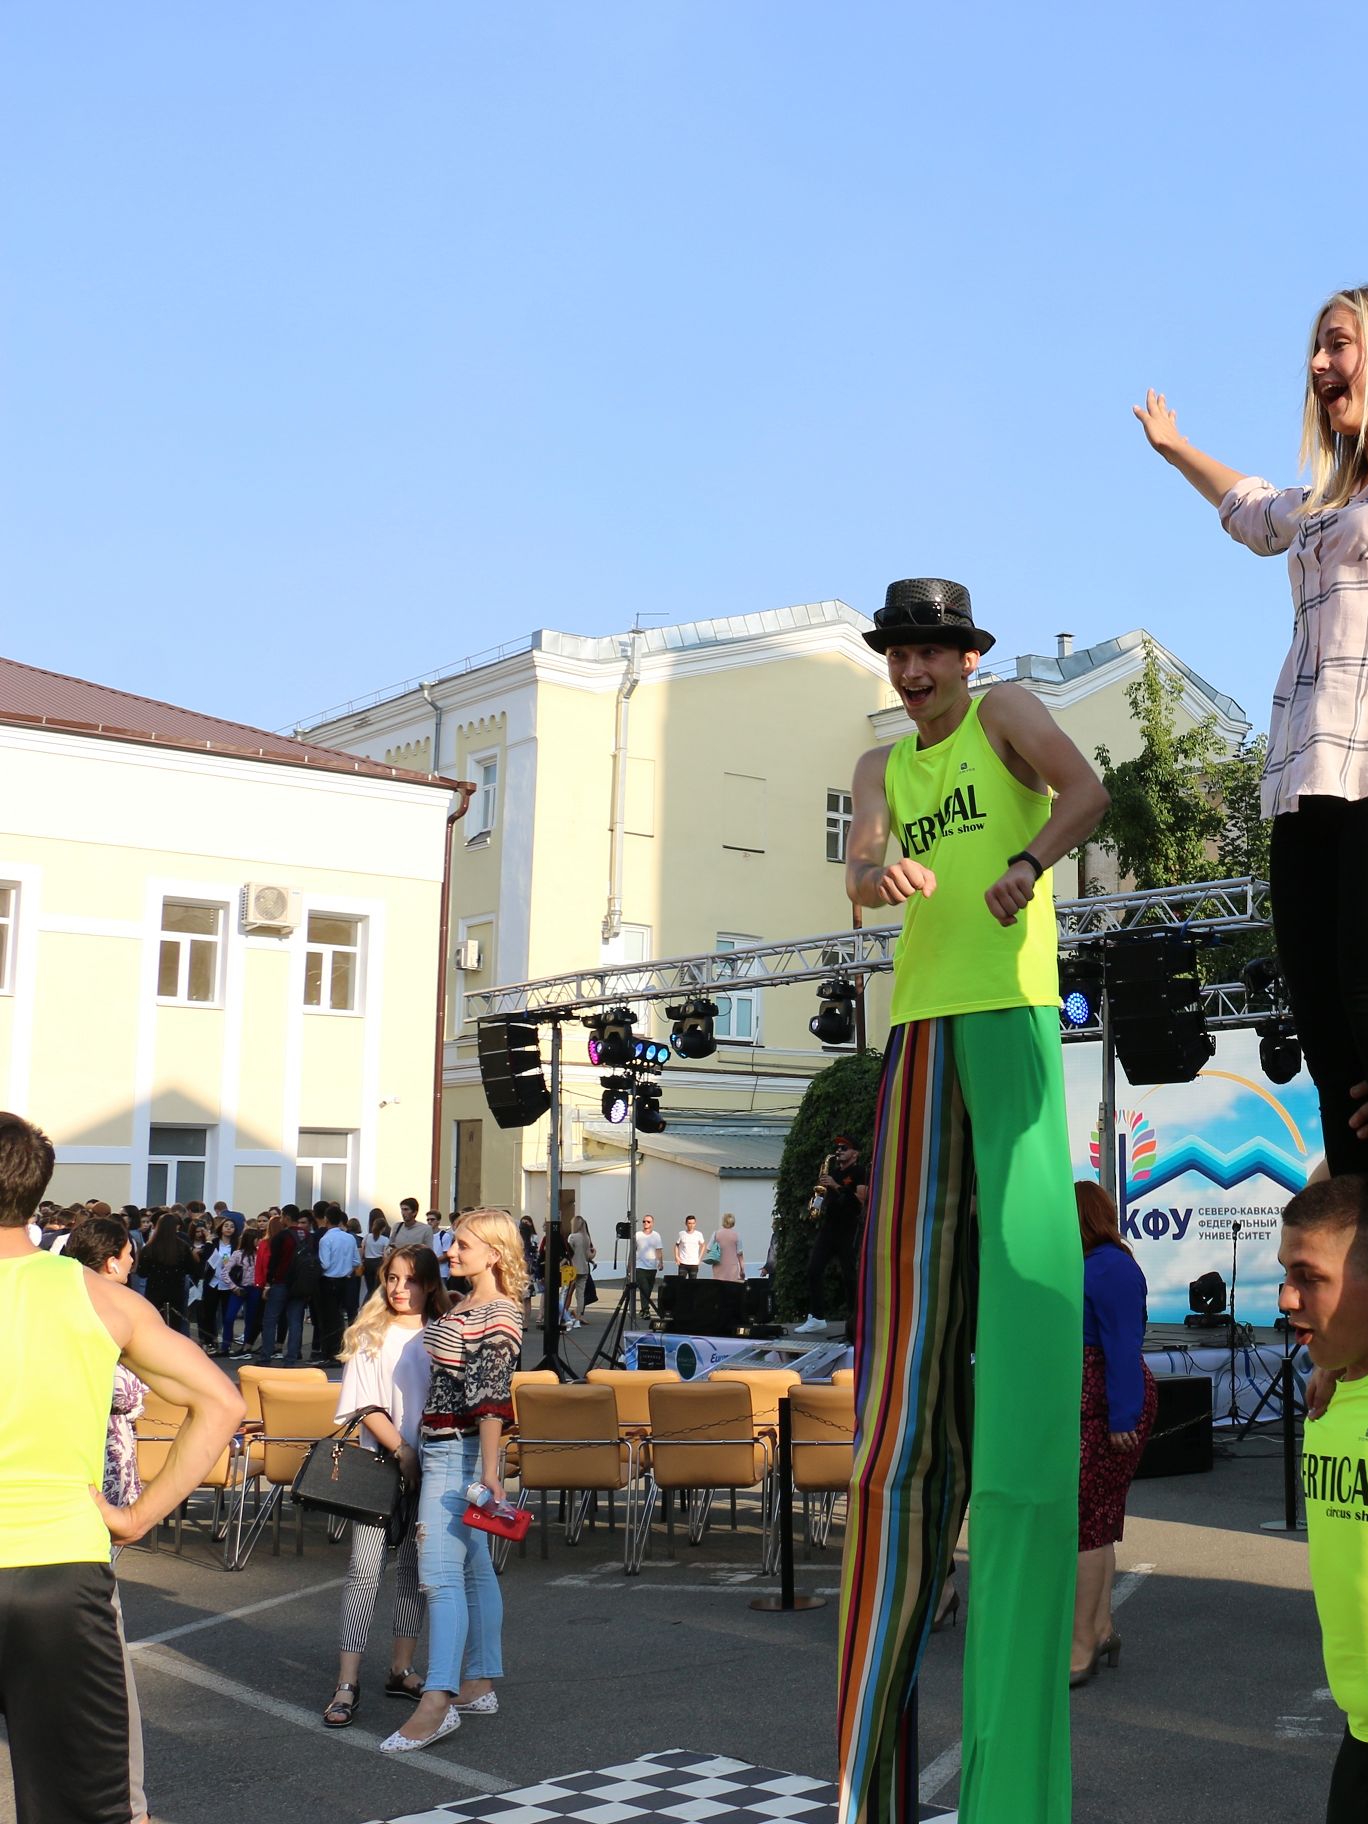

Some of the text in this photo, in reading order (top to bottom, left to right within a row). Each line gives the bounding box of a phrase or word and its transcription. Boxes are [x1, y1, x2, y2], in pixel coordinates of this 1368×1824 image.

[957, 823, 985, 834] show
[1198, 1218, 1278, 1229] ФЕДЕРЛЬНЫЙ
[1326, 1506, 1352, 1520] circus
